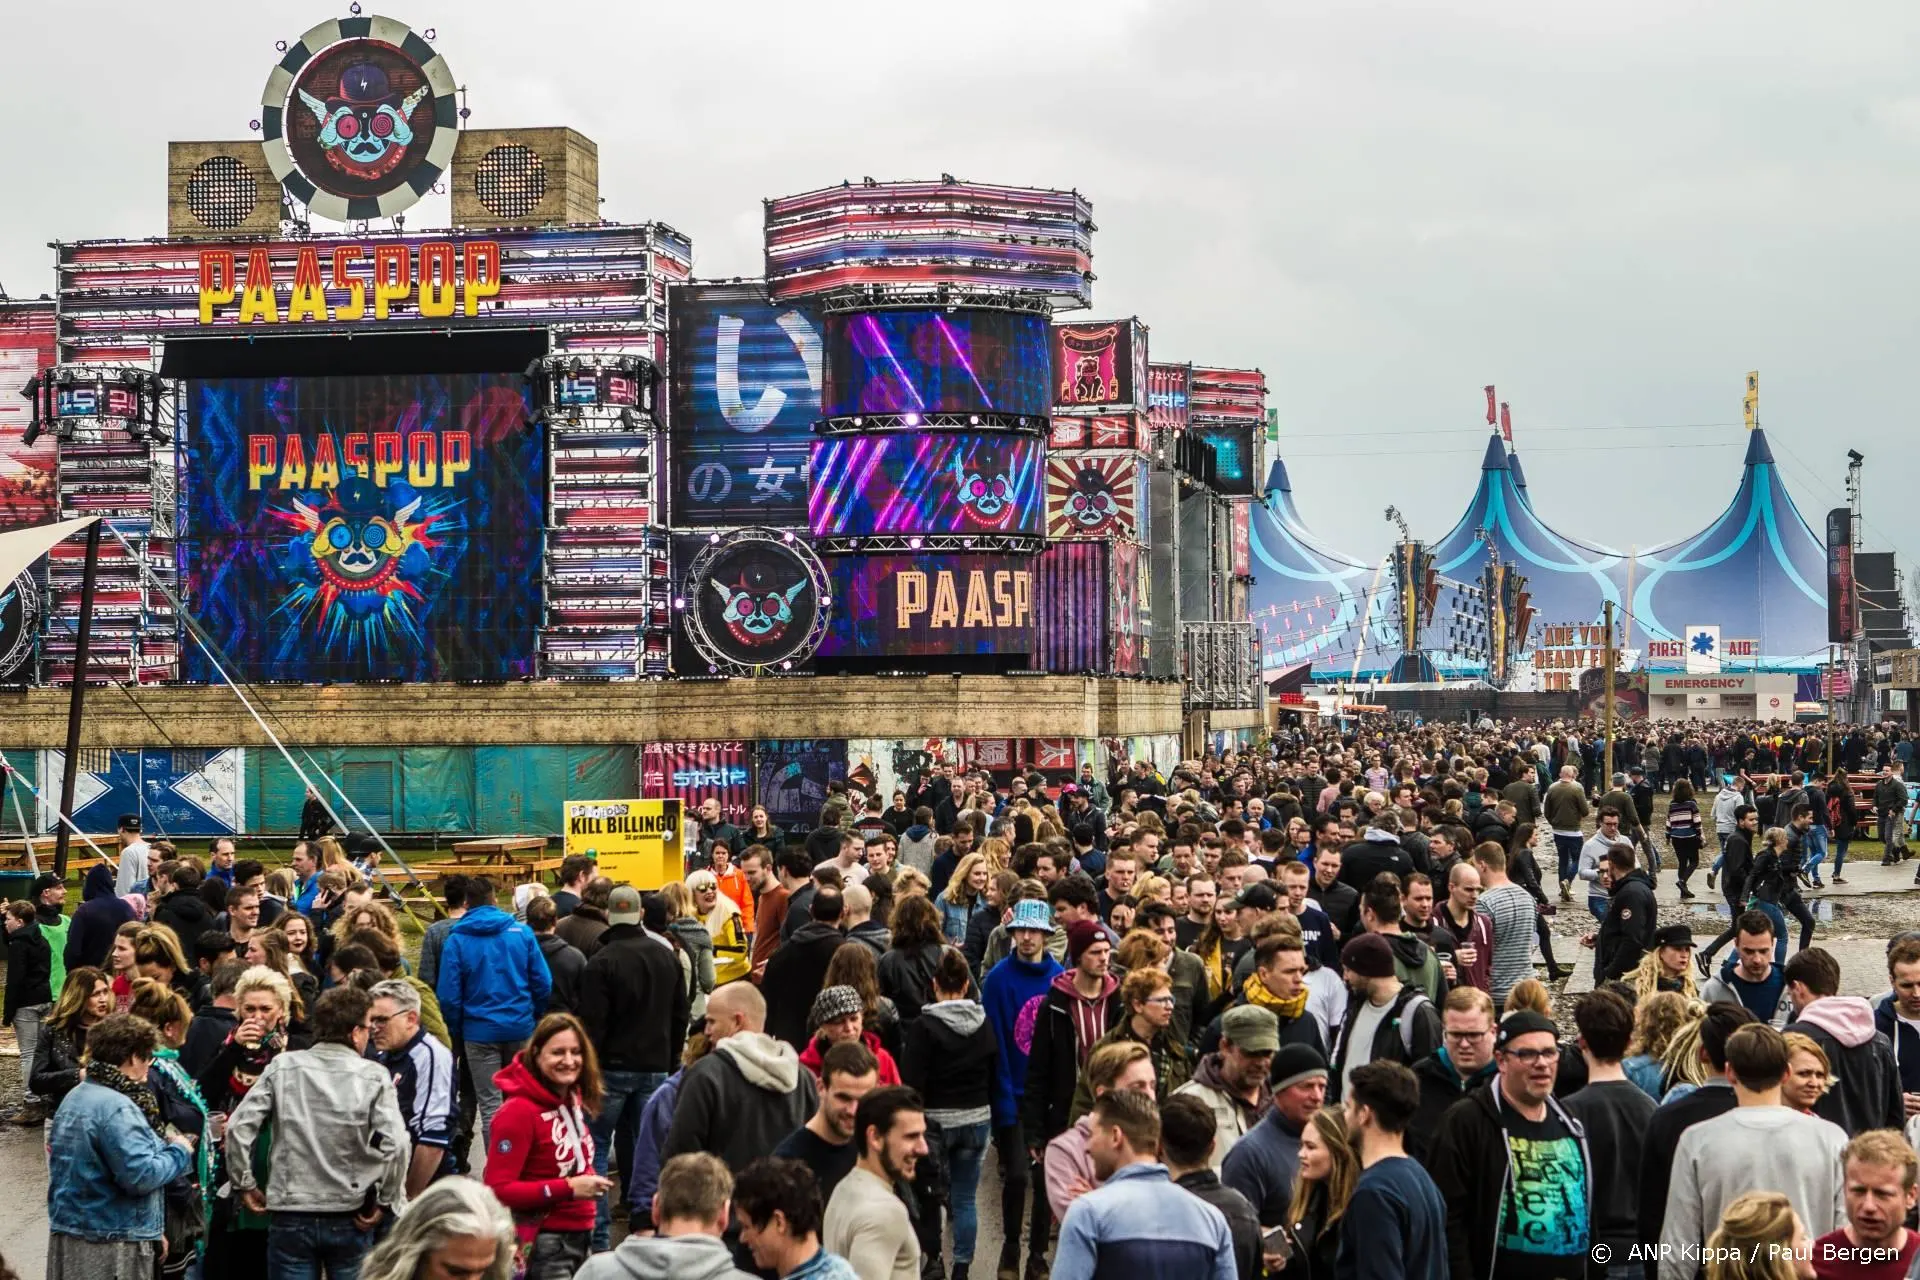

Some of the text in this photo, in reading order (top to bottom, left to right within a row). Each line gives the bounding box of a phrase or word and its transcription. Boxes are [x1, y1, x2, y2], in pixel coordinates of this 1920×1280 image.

[199, 241, 499, 324] PAASPOP
[248, 431, 471, 490] PAASPOP
[896, 570, 1033, 628] PAASP
[1535, 649, 1586, 669] READY
[1649, 641, 1751, 656] FIRST AID
[1665, 679, 1745, 688] EMERGENCY
[571, 814, 677, 835] KILL BILLINGO
